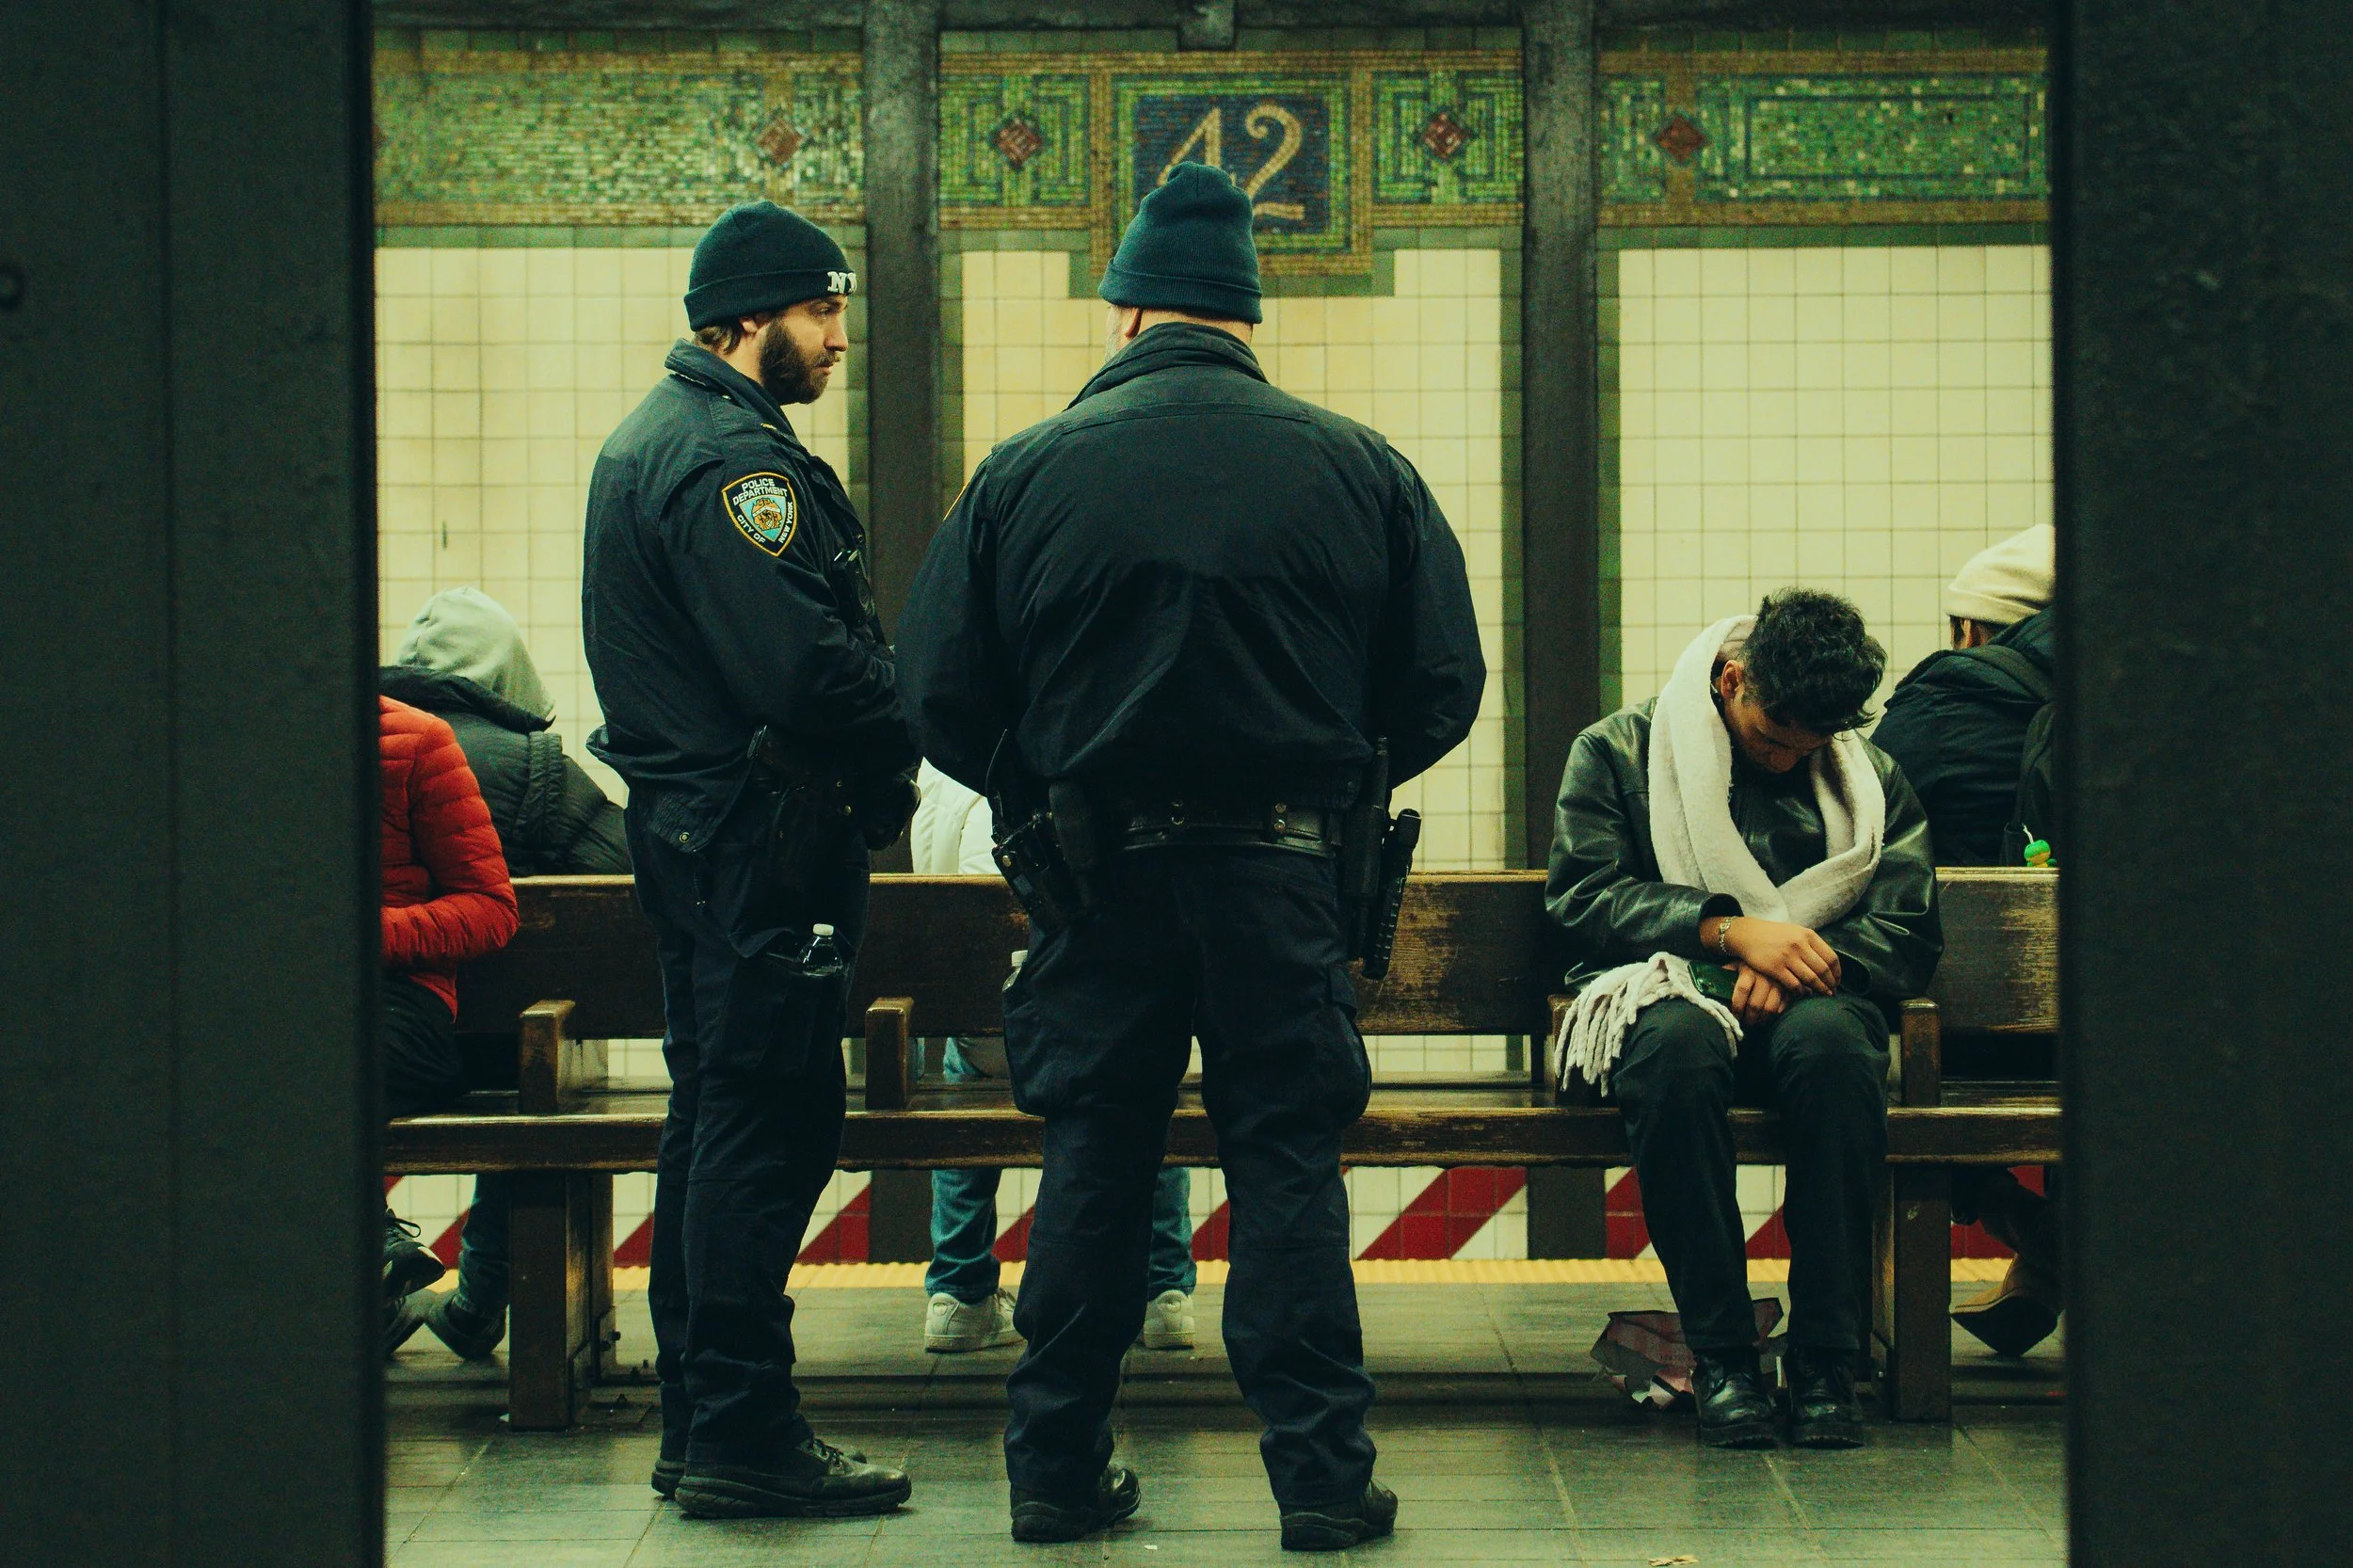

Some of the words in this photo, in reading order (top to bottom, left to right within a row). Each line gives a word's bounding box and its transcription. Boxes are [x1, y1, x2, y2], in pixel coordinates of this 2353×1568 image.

[1157, 104, 1305, 221] 42
[741, 478, 776, 492] POLICE
[732, 487, 788, 505] DEPARTMENT
[737, 514, 755, 534] CITY
[753, 534, 766, 544] OF
[778, 525, 791, 543] NEW
